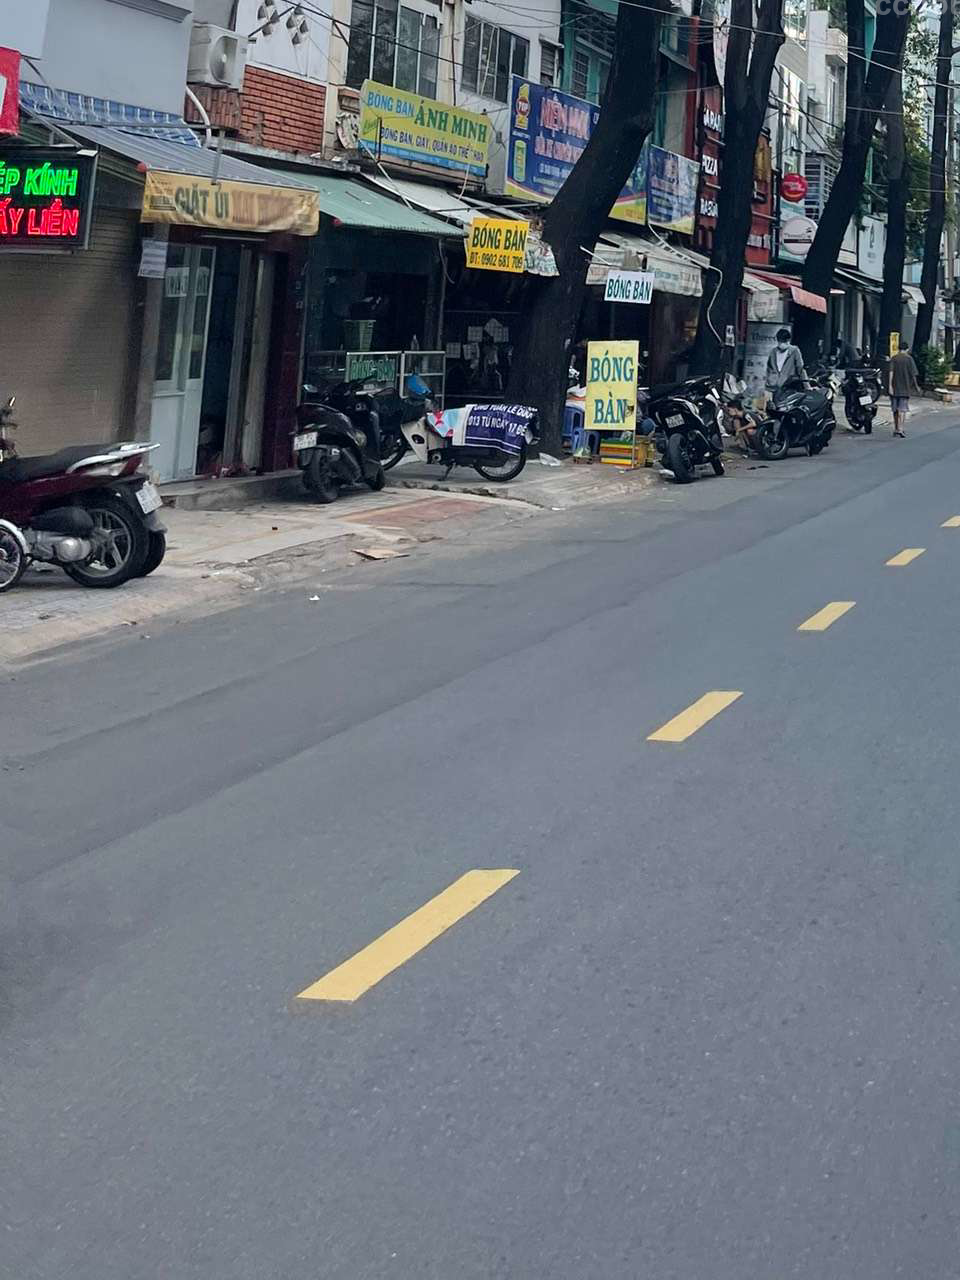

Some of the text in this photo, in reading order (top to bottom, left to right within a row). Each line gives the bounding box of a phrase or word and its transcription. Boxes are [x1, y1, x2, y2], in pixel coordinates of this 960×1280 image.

[451, 114, 488, 143] MINH
[24, 162, 79, 196] KÍNH
[174, 183, 209, 221] GIẶT
[472, 223, 528, 252] BÓNG BÀN
[606, 276, 632, 299] BÓNG
[632, 277, 652, 301] BÀN
[590, 350, 635, 384] BÓNG
[593, 391, 628, 425] BÀN
[508, 422, 518, 433] 17
